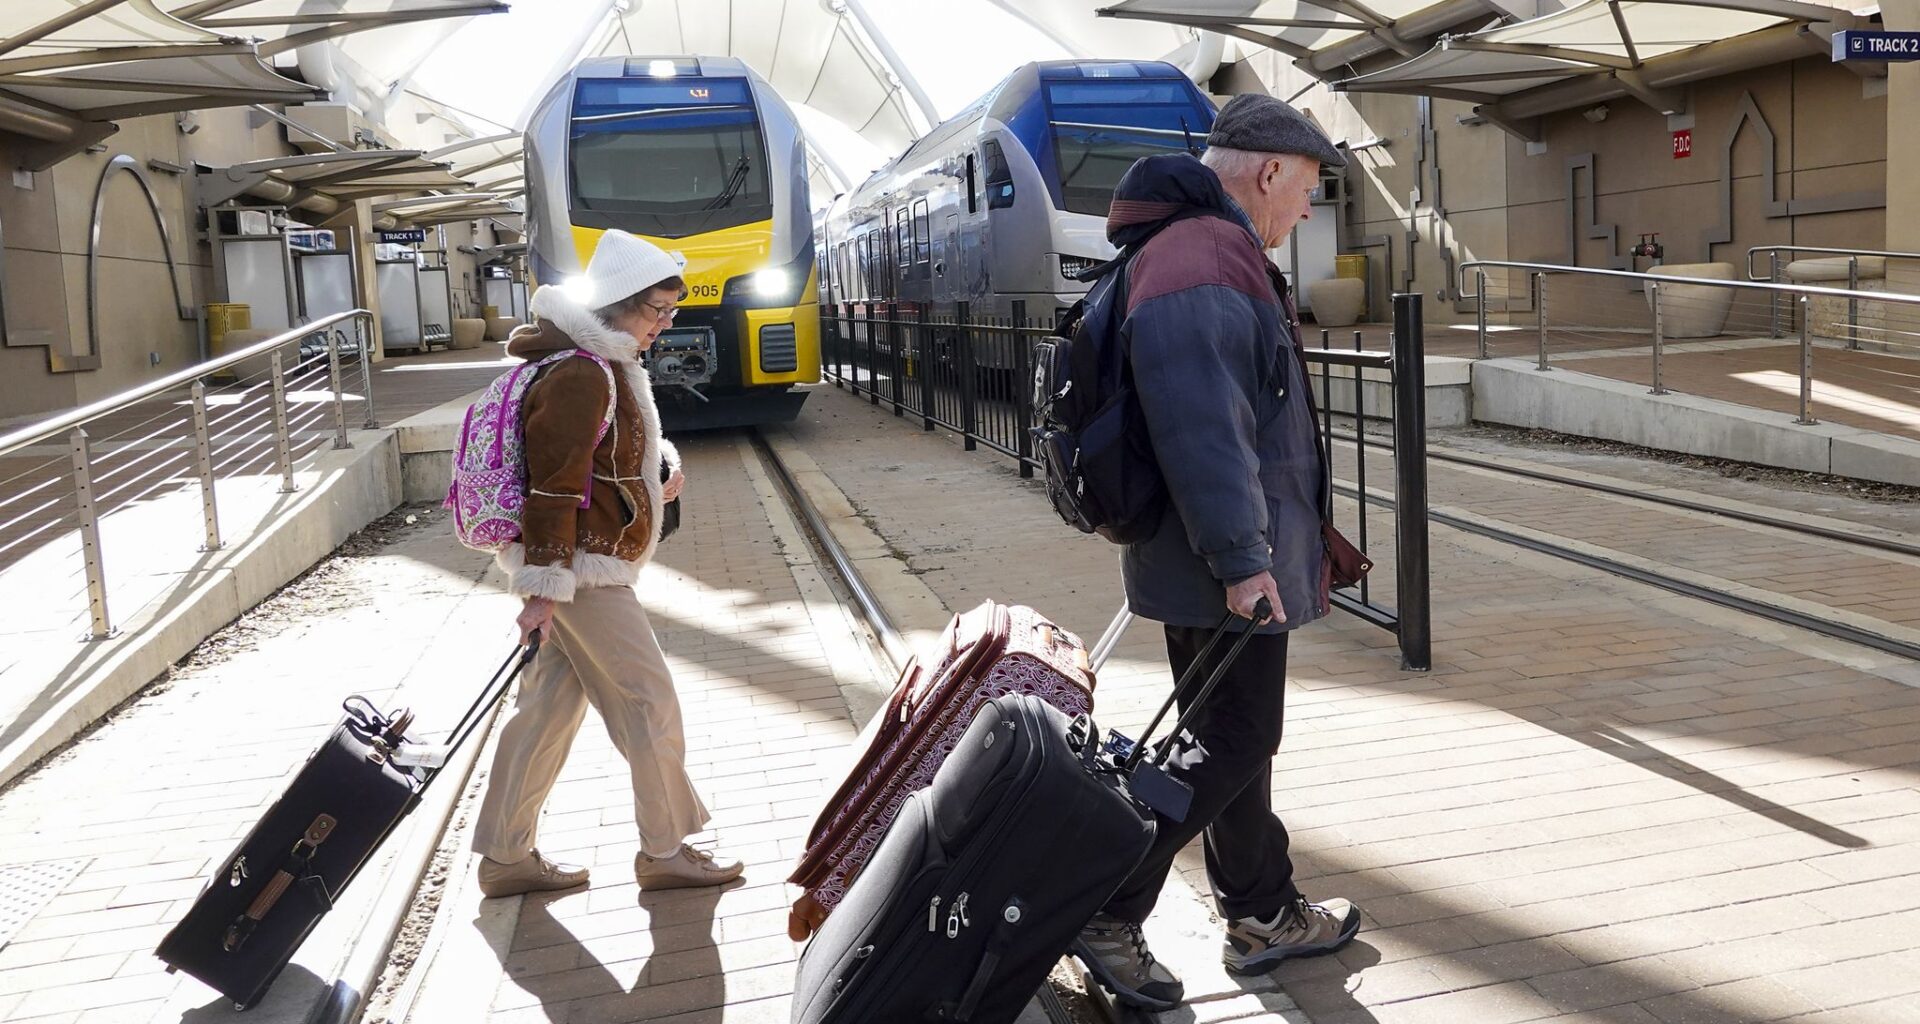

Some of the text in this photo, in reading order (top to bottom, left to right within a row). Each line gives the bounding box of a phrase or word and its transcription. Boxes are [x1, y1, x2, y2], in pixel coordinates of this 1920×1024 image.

[1868, 38, 1919, 52] TRACK 2
[384, 232, 408, 240] TRACK
[692, 285, 718, 297] 905
